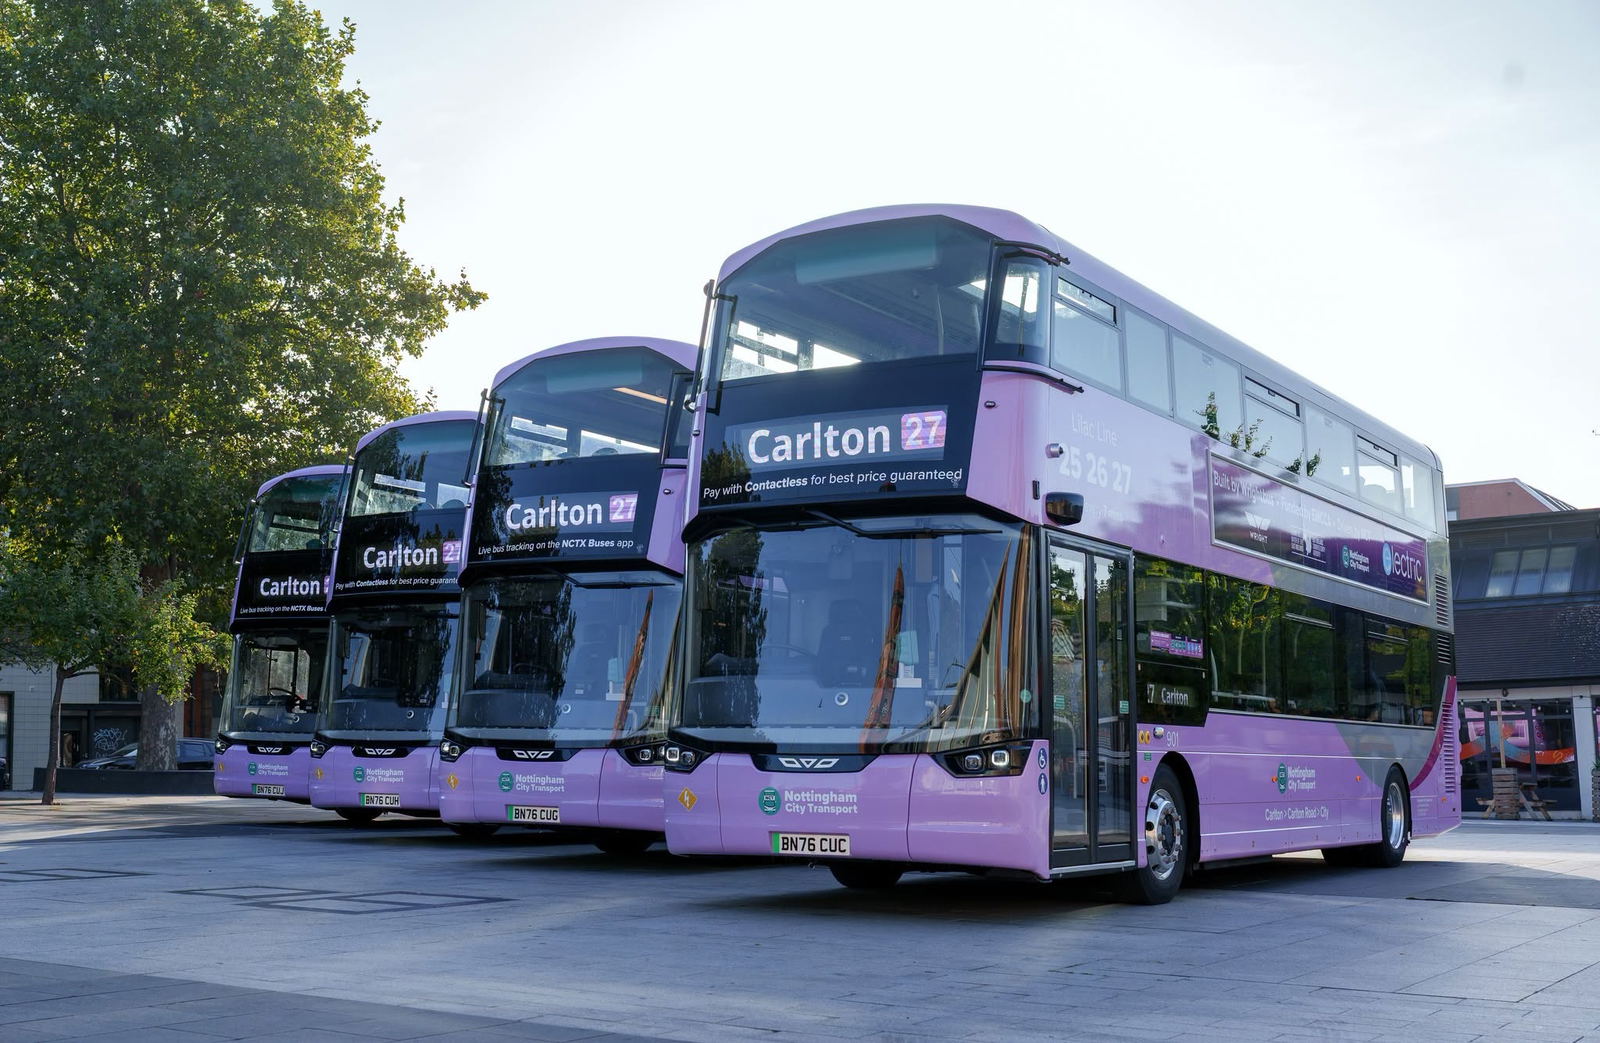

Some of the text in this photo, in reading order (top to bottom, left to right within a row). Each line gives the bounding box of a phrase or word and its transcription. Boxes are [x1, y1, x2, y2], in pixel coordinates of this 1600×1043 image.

[748, 414, 943, 464] Carlton 27
[1059, 442, 1132, 494] 25 26 27
[703, 468, 962, 499] Pay with Contactless for best price guaranteed
[1213, 470, 1230, 490] Built
[1230, 476, 1240, 496] by
[505, 498, 637, 530] Carlton 27
[478, 538, 634, 555] Live bus tracking on the NCTX Buses app
[363, 544, 438, 569] Carlton
[259, 575, 320, 597] Carlton
[335, 582, 345, 590] Pay
[356, 579, 389, 587] Contactless
[398, 577, 412, 585] best
[412, 577, 429, 586] price
[256, 605, 274, 613] tracking
[1161, 687, 1189, 706] Carlton
[1166, 731, 1179, 748] 901
[366, 768, 404, 777] Nottingham
[366, 775, 378, 783] City
[515, 774, 565, 785] Nottingham
[515, 783, 565, 793] City Transport
[365, 795, 399, 805] BN76 CUH
[784, 790, 857, 804] Nottingham
[514, 808, 558, 821] BN76 CUG
[785, 803, 858, 815] City Transport
[781, 836, 847, 853] BN76 CUC
